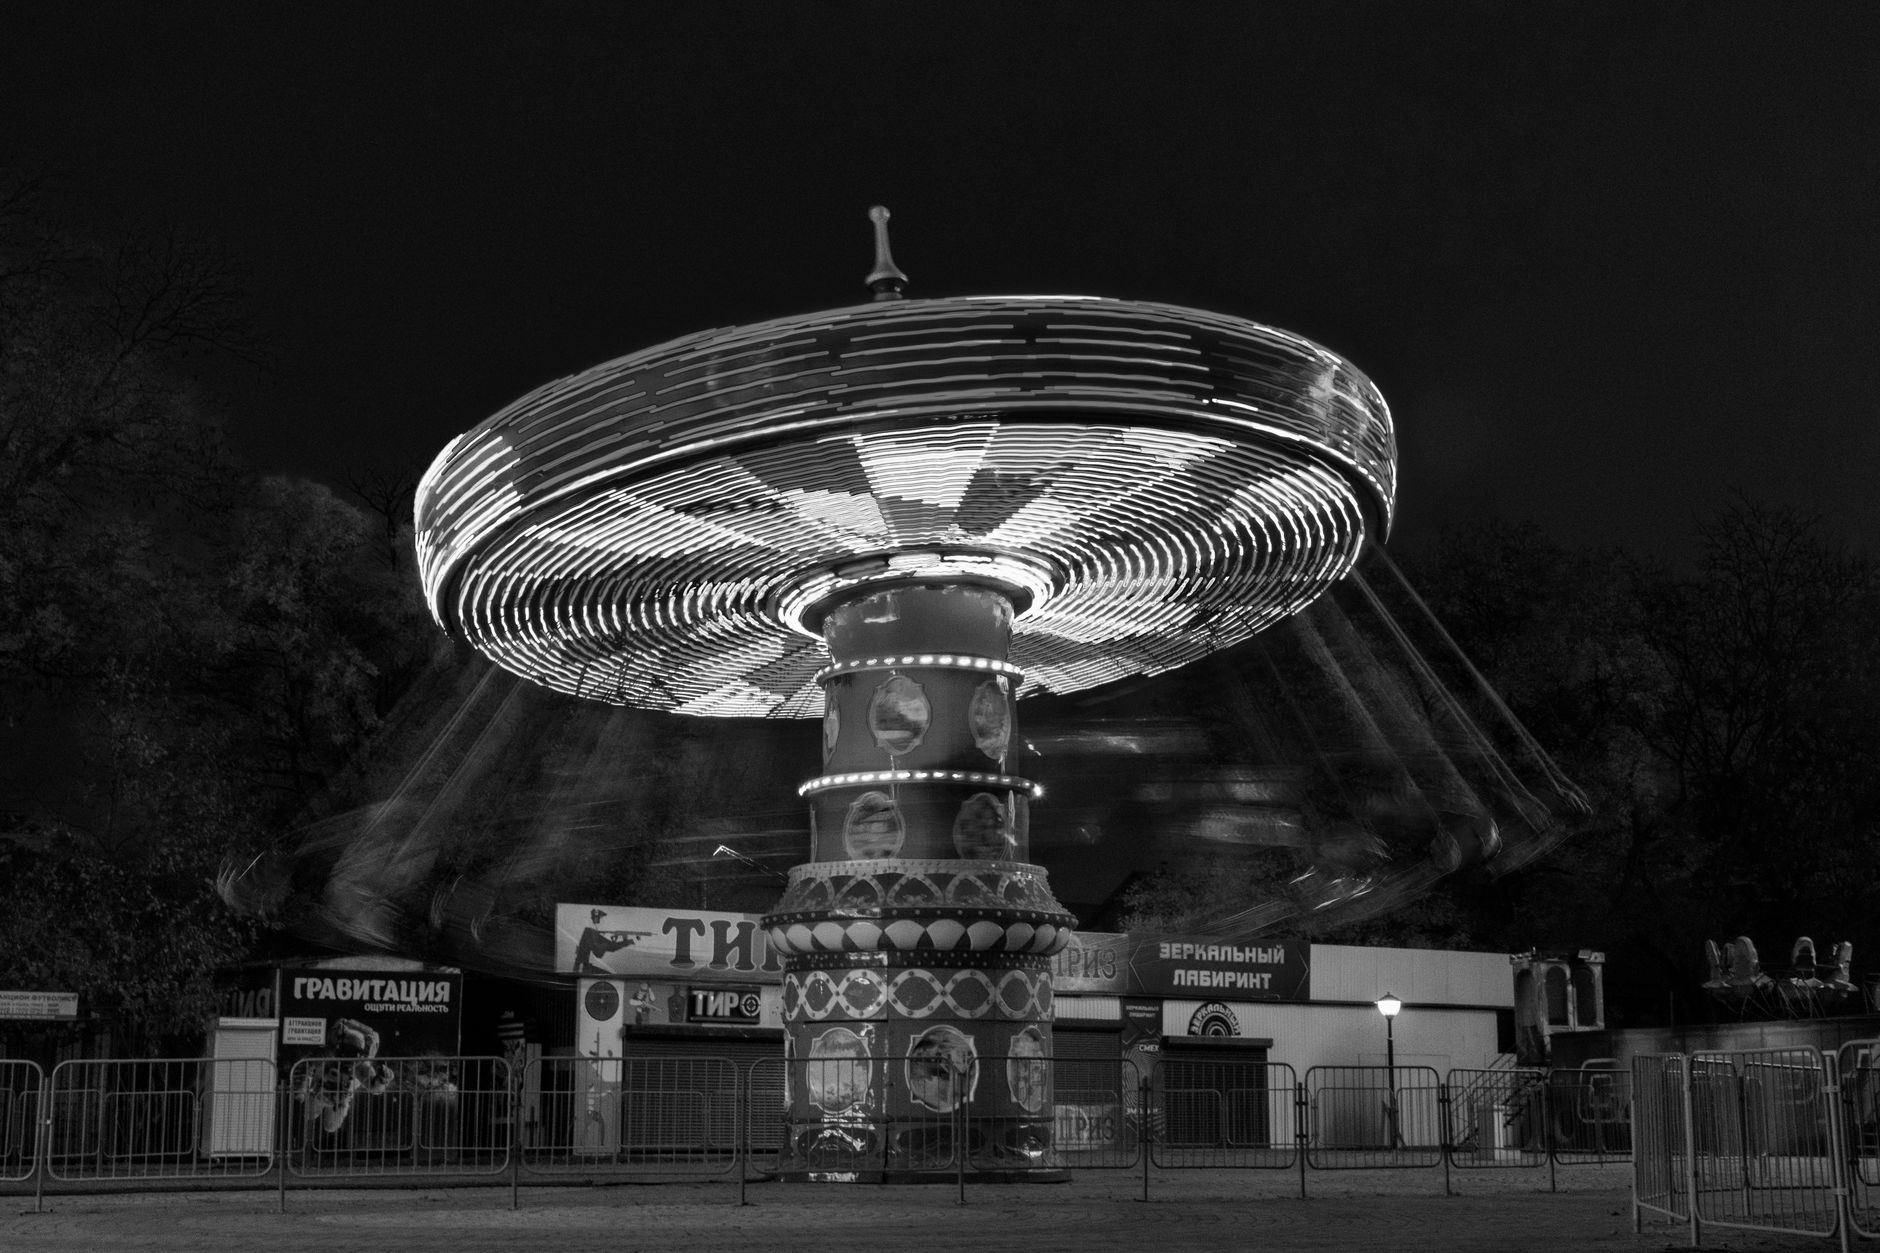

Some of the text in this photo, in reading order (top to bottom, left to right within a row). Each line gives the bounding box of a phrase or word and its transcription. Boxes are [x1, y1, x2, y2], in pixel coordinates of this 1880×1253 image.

[1159, 942, 1285, 964] ЗЕРКАЛЬНЫЙ
[1173, 968, 1272, 989] ЛАБИРИНТ
[293, 976, 450, 1006] ГРАВИТАЦИЯ
[364, 1003, 449, 1014] ОЩУТИ РЕАЛЬНОСТЬ
[692, 990, 739, 1016] ТИР
[1138, 1044, 1160, 1052] СМЕХ
